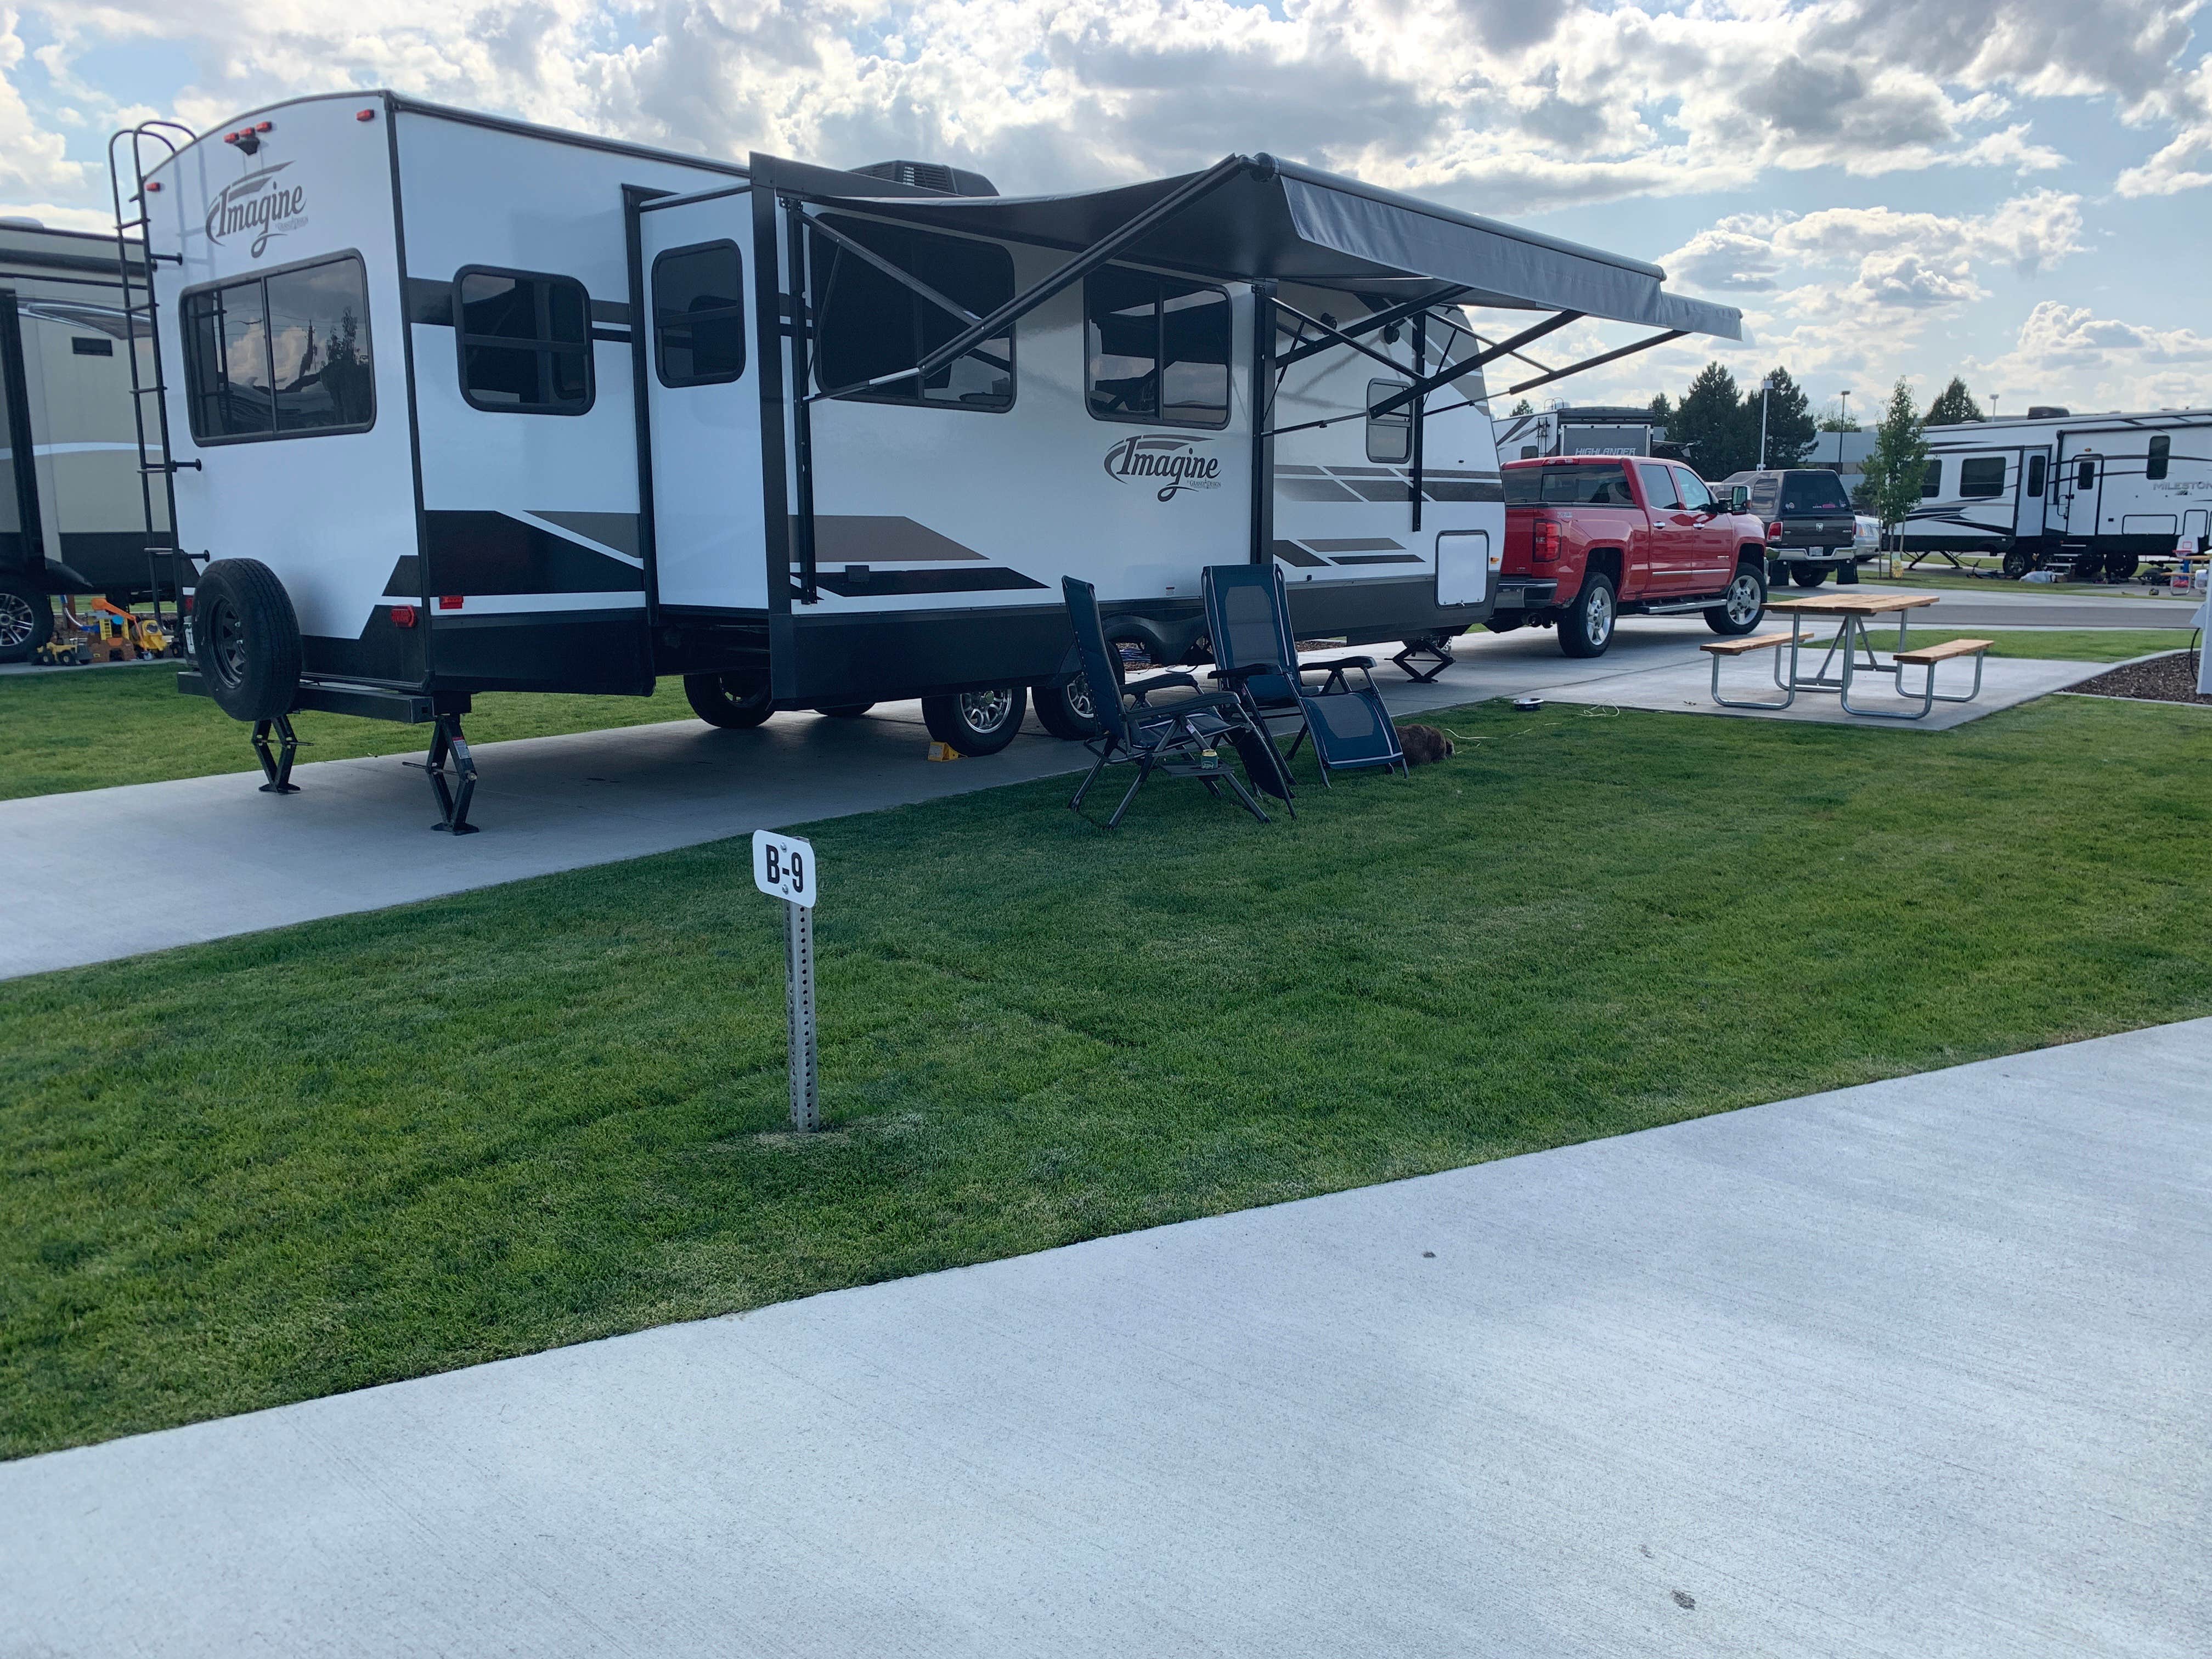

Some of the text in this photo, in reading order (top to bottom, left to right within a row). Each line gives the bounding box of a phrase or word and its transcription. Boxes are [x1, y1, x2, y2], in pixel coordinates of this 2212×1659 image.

[215, 180, 307, 258] Imagine
[1116, 435, 1222, 502] Imagine
[1575, 448, 1636, 456] HIGHLANDER
[766, 844, 803, 893] B-9
